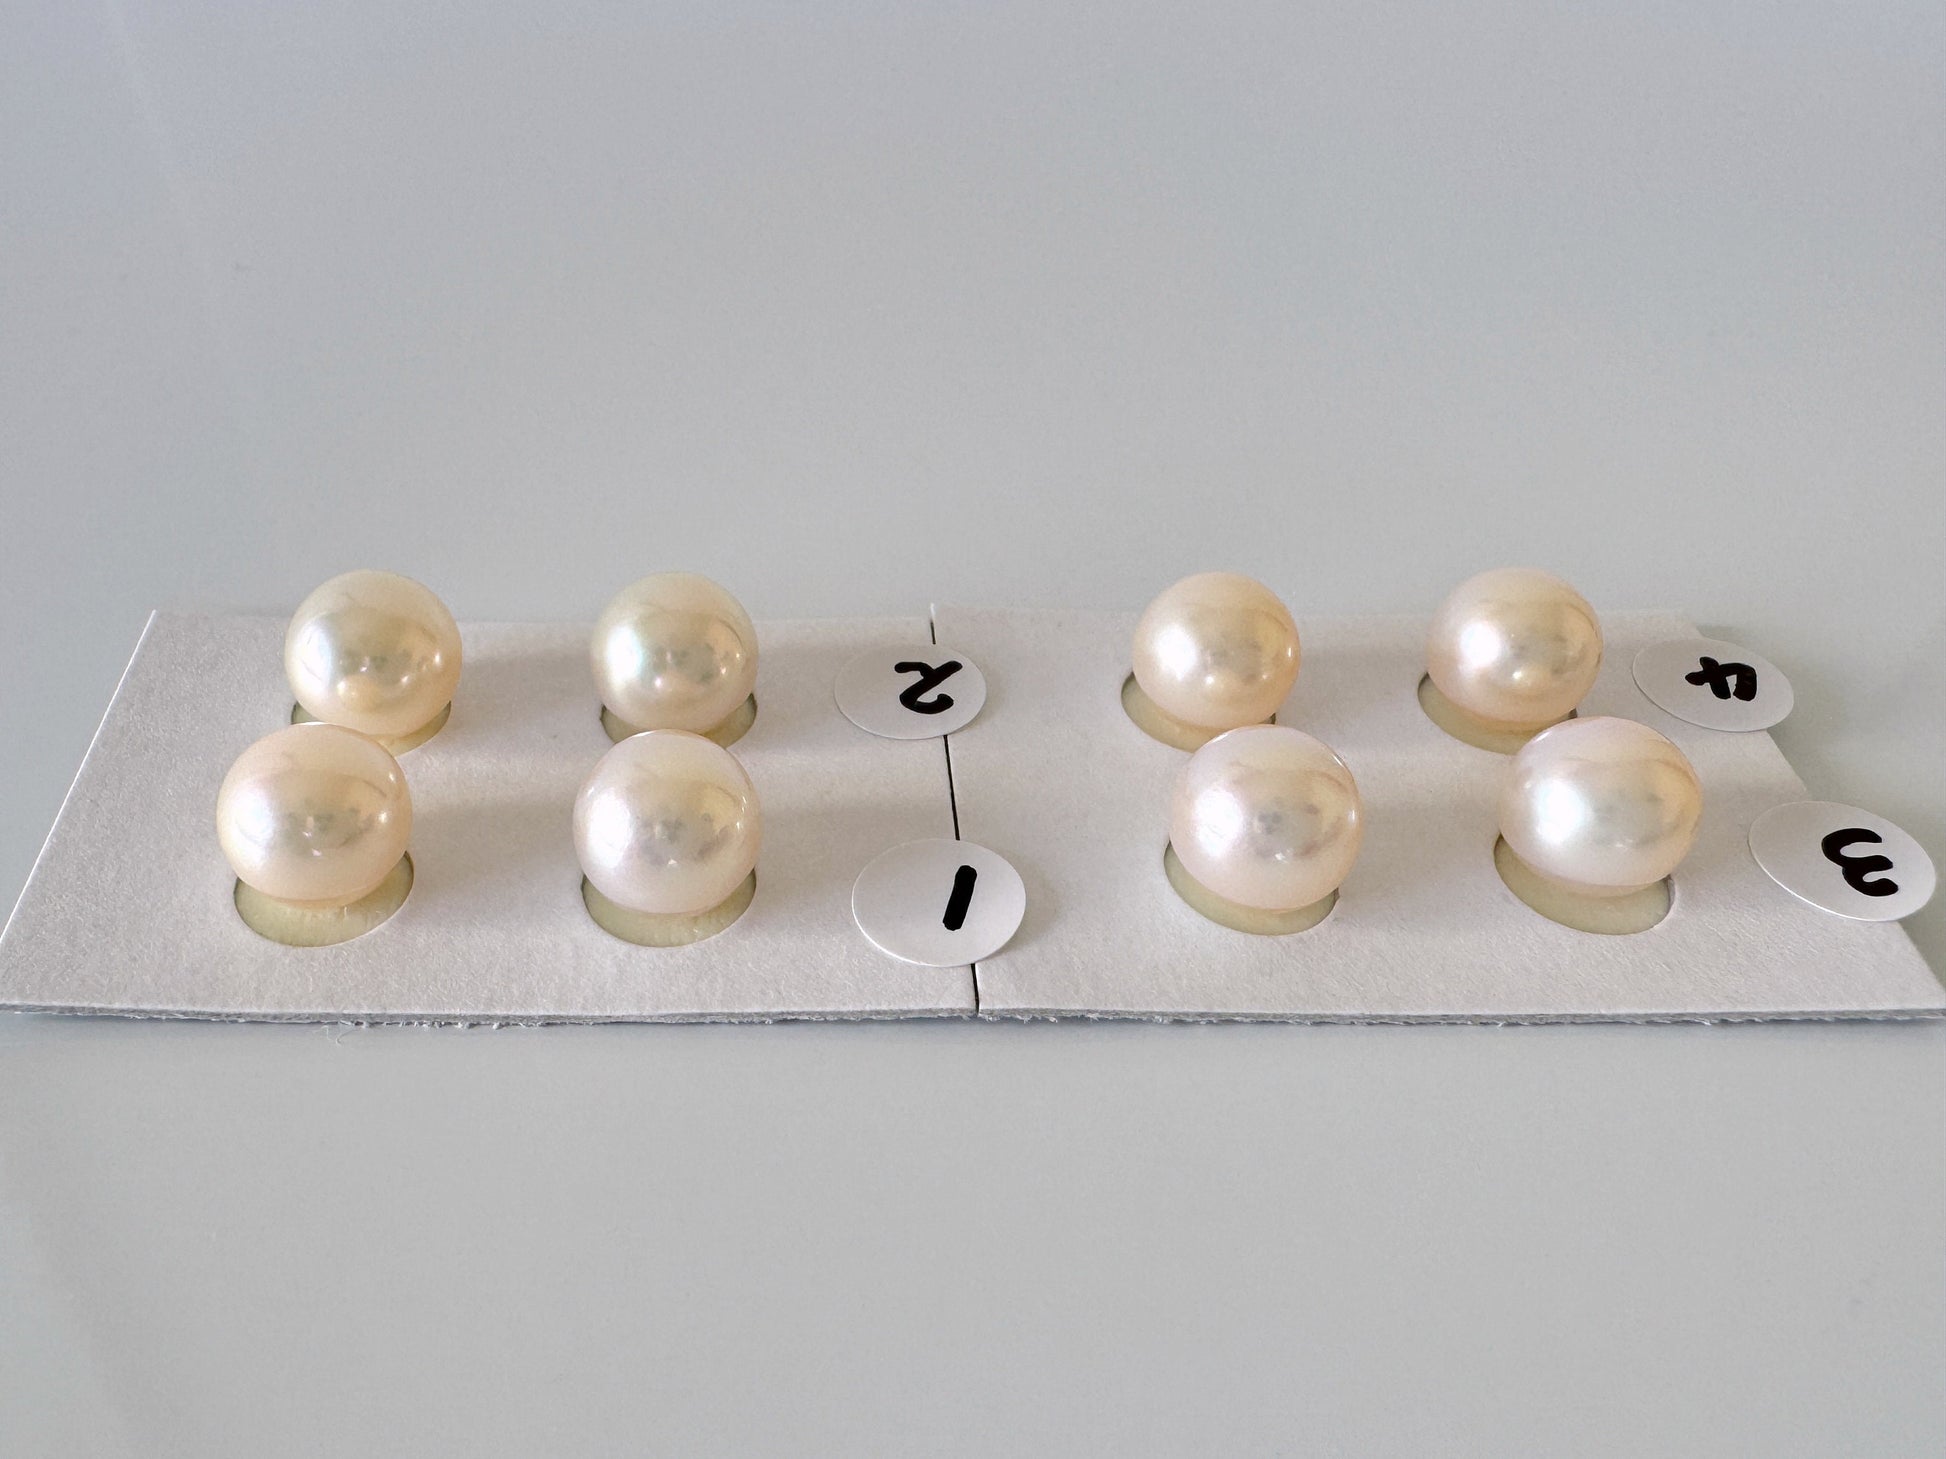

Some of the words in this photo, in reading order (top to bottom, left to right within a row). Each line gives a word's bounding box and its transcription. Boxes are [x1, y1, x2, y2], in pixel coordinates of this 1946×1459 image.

[893, 660, 963, 715] 2
[1684, 656, 1758, 702] 4
[1821, 827, 1899, 897] 3
[942, 864, 978, 932] 1
